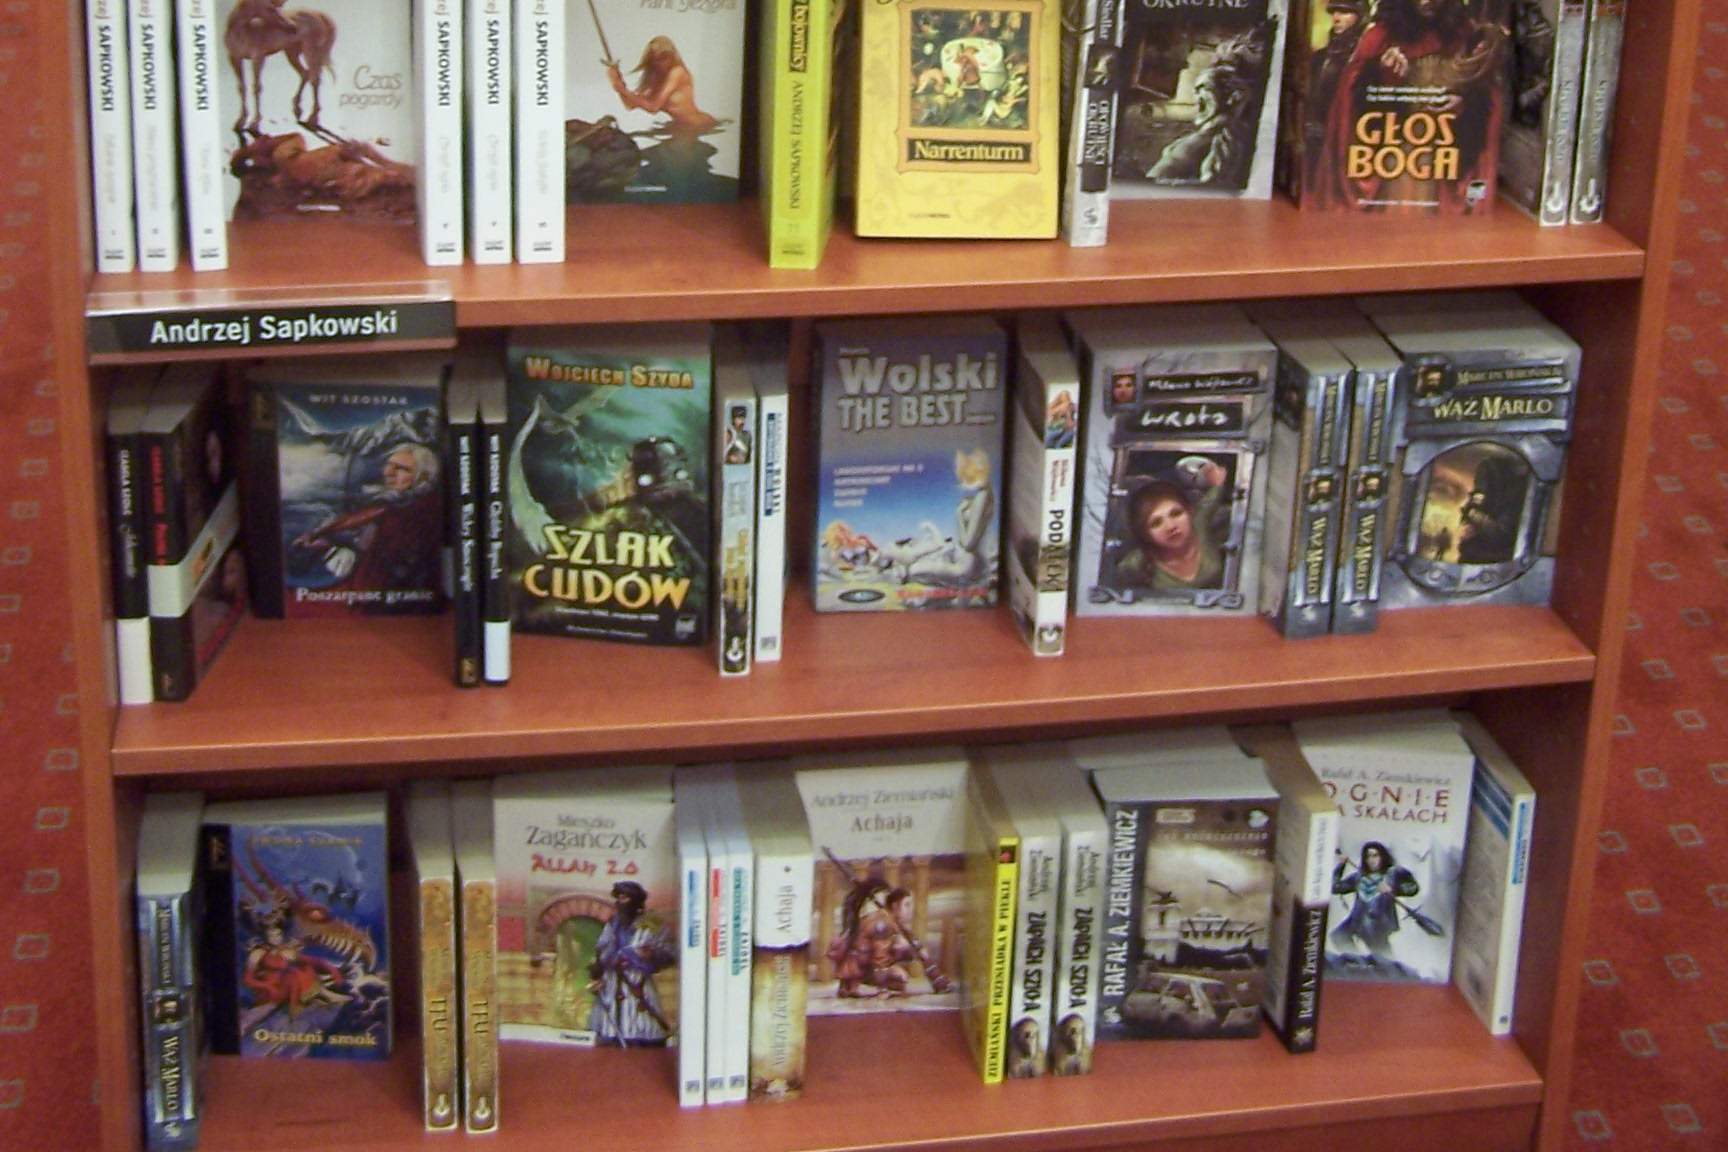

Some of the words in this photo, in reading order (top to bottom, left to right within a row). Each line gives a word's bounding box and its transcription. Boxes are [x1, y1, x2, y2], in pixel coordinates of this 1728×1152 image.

[789, 6, 810, 72] bojownicy
[97, 24, 115, 112] SAPKOWSKI
[140, 23, 157, 111] SAPKOWSKI
[192, 24, 210, 111] SAPKOWSKI
[353, 65, 401, 92] Czas
[436, 20, 450, 107] SAPKOWSKI
[486, 19, 499, 105] SAPKOWSKI
[535, 19, 549, 107] SAPKOWSKI
[792, 83, 803, 135] ANDRZEJ
[1355, 112, 1458, 146] GŁOS
[790, 137, 802, 209] SAPKOWSKI
[914, 141, 1024, 162] Narrenturm
[1347, 144, 1460, 181] BOGA
[151, 317, 251, 345] Andrzej
[259, 310, 399, 339] Sapkowski
[525, 356, 624, 385] WOJCIECH
[631, 366, 694, 389] SZYDA
[838, 352, 998, 395] Wolski
[838, 396, 891, 433] THE
[900, 393, 969, 428] BEST
[1480, 396, 1553, 421] MARLO
[544, 524, 675, 568] SZLAK
[296, 586, 382, 605] Poszarpane
[523, 565, 690, 610] CUDÓW
[558, 814, 616, 830] Mieszko
[850, 811, 913, 834] Achaja
[1354, 805, 1449, 824] SKAŁACH
[525, 824, 650, 851] Zagańczyk
[530, 854, 598, 875] ALLAH
[607, 859, 640, 875] 2.0
[1109, 809, 1138, 917] ZIEMKIEWICZ
[776, 883, 799, 934] Achaja
[1110, 919, 1130, 937] A.
[1303, 908, 1323, 975] Ziemkiewicz
[1103, 939, 1129, 996] RAFAŁ
[254, 1029, 323, 1046] Ostatni
[327, 1031, 377, 1047] smok
[160, 1066, 180, 1111] MARLO
